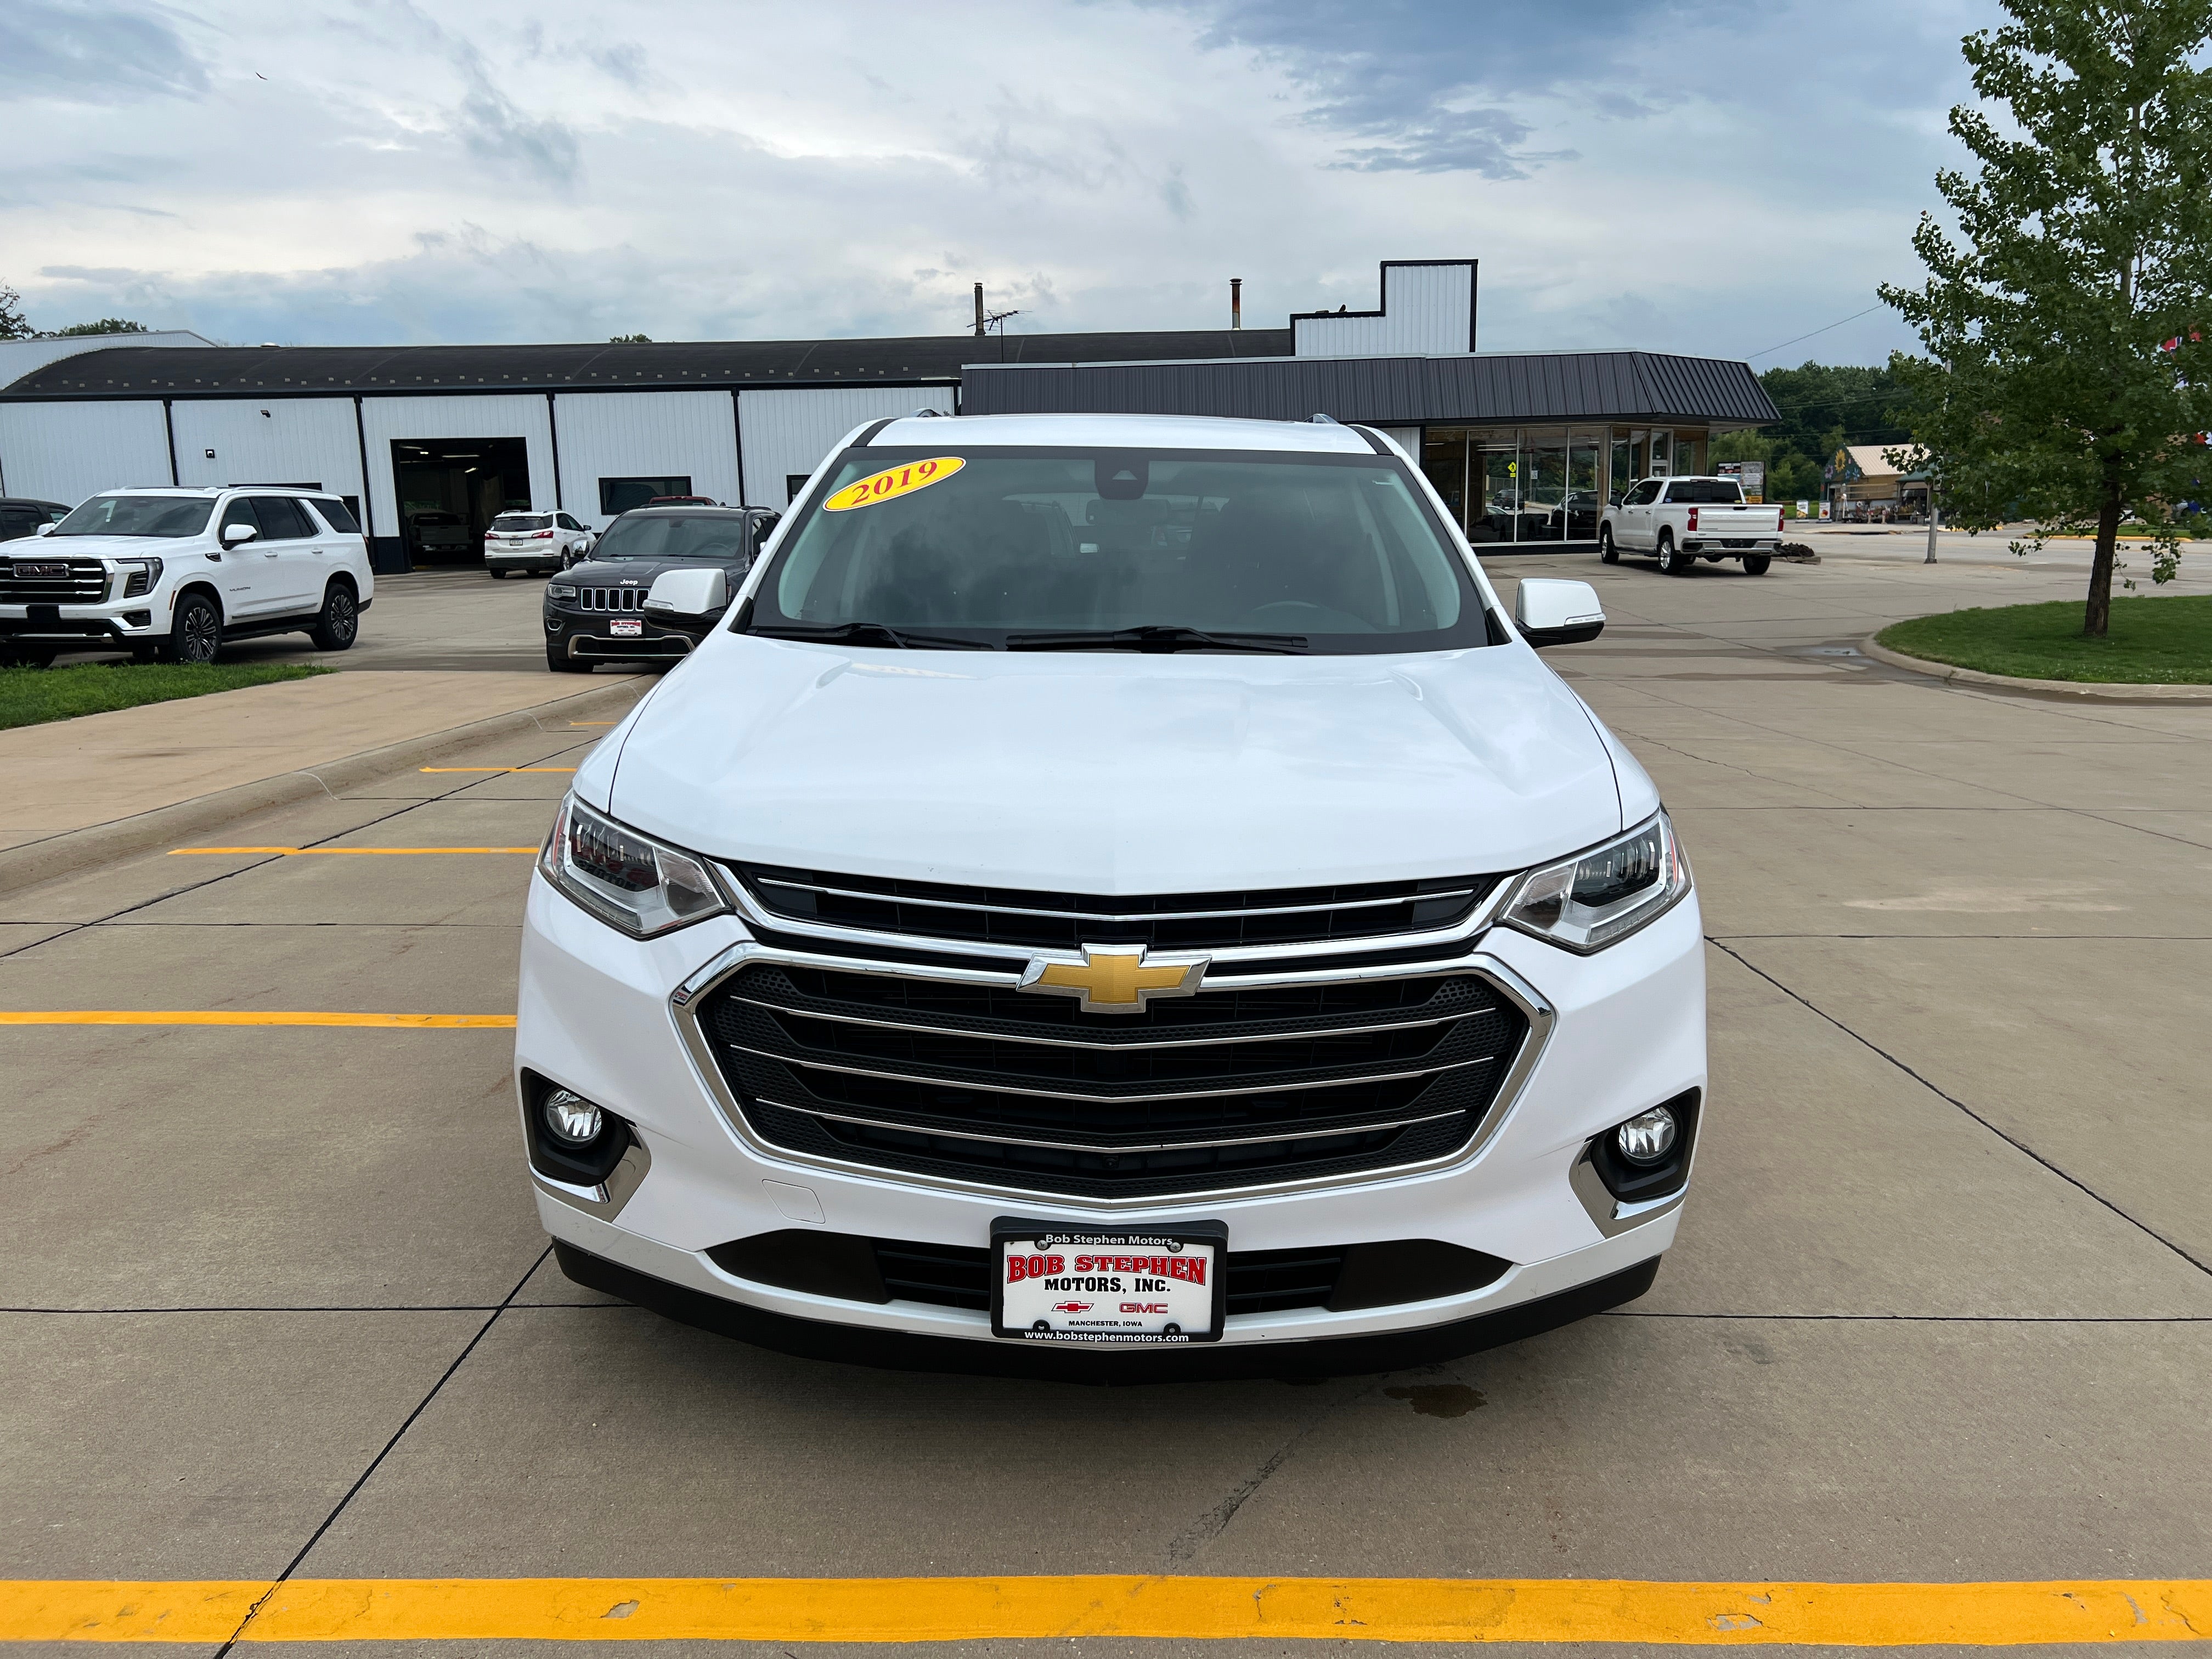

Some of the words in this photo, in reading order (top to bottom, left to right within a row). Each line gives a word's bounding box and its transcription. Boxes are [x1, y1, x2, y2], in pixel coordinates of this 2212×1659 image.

[851, 461, 938, 505] 2019
[16, 566, 65, 575] GMC
[1045, 1234, 1070, 1244] Bob
[1073, 1235, 1125, 1245] Stephen
[1128, 1235, 1173, 1245] Motors
[1007, 1254, 1065, 1284] BOB
[1074, 1254, 1207, 1286] STEPHEN
[1044, 1277, 1127, 1294] MOTORS,
[1135, 1278, 1171, 1292] INC.
[1119, 1302, 1169, 1314] GMC
[1024, 1331, 1189, 1342] www.bobstephenmotors.com
